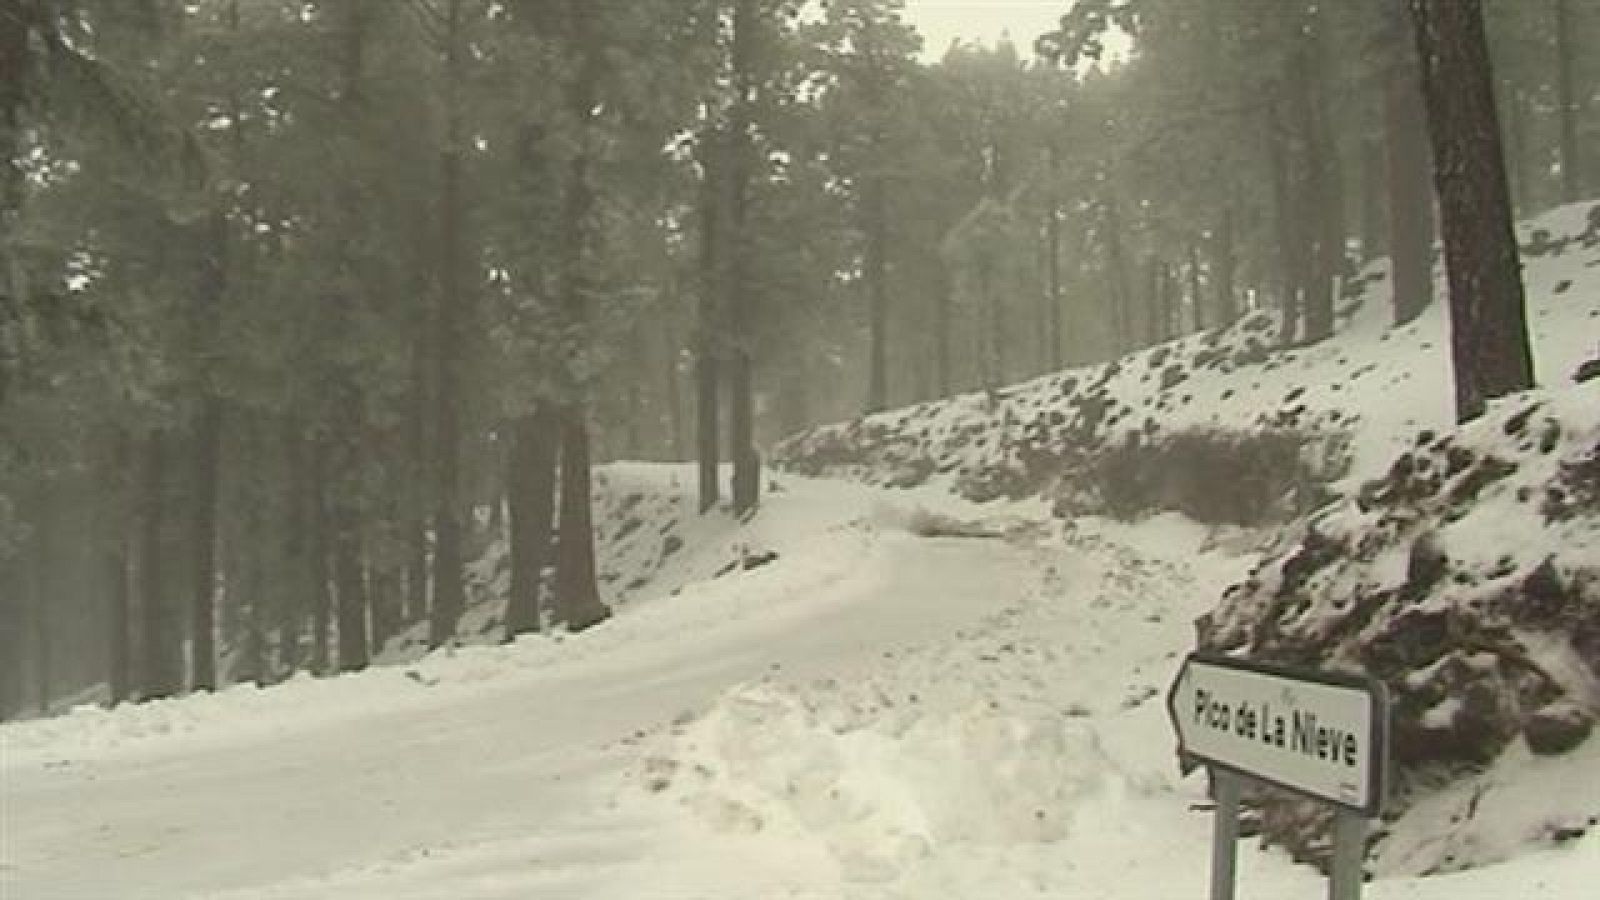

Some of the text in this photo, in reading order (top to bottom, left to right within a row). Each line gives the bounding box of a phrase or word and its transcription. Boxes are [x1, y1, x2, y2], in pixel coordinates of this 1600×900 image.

[1194, 688, 1357, 767] Pico de La Nieve
